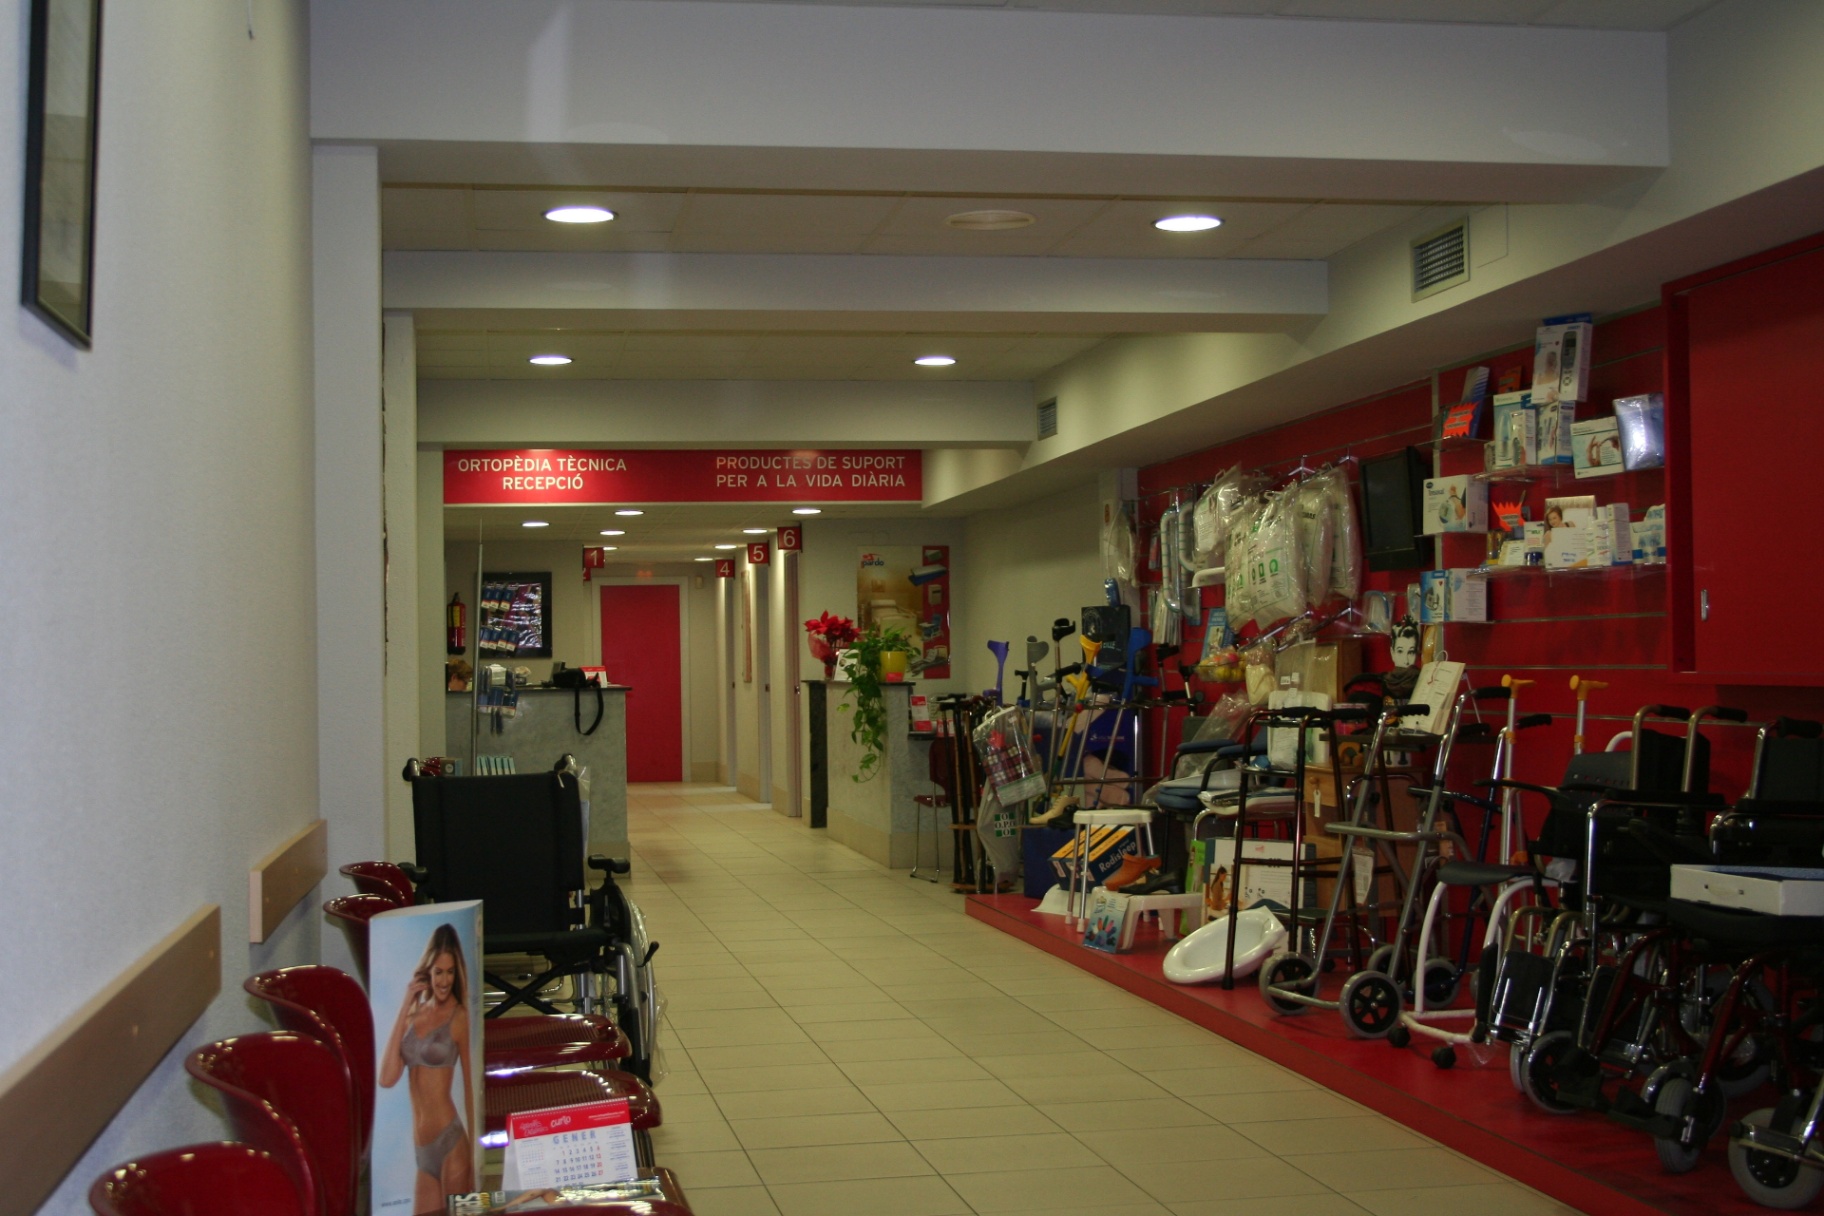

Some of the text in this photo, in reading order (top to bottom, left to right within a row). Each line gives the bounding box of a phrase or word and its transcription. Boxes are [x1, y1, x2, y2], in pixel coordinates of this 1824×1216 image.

[458, 455, 627, 472] ORTOPÈDIA TÈCNICA
[716, 456, 905, 469] PRODUCTES DE SUPORT
[502, 474, 584, 490] RECEPCIÓ
[716, 471, 906, 487] PER A LA VIDA DIÀRIA
[783, 529, 796, 548] 6
[590, 550, 598, 566] 1
[753, 545, 765, 562] 5
[719, 562, 730, 576] 4
[1098, 841, 1136, 873] Rodisleep
[552, 1130, 597, 1145] GENER
